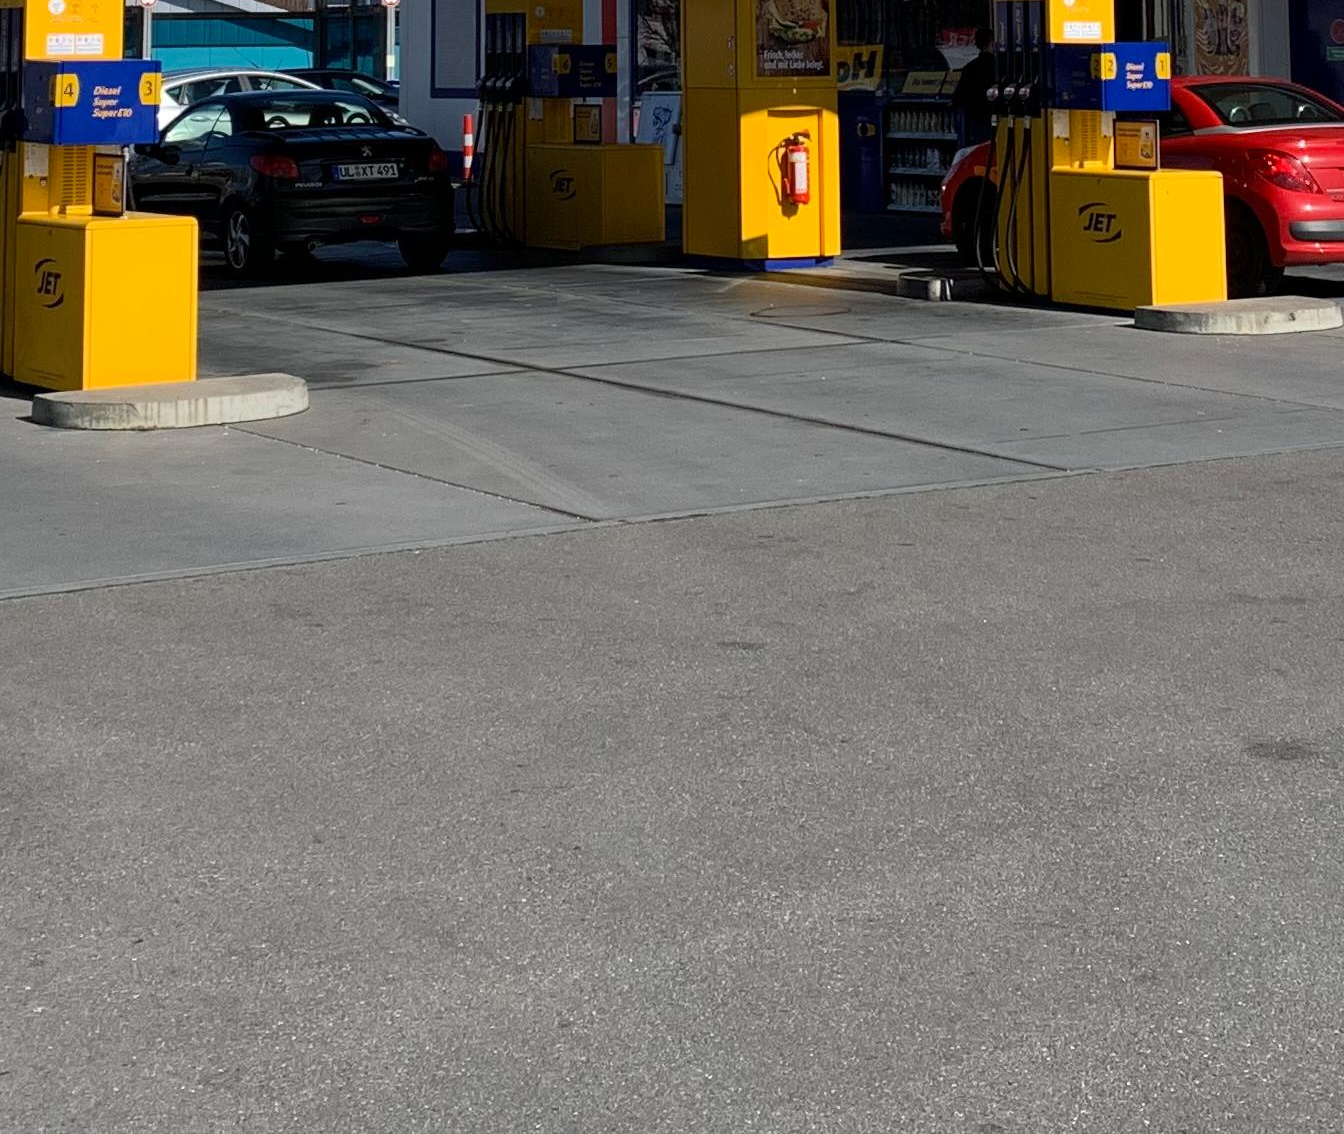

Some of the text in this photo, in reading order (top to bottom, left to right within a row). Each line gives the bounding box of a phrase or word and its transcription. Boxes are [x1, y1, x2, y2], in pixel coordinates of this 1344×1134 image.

[63, 82, 75, 98] 4
[93, 85, 122, 96] Diesel
[144, 80, 154, 97] 3
[92, 97, 119, 109] Super
[339, 166, 354, 178] UL
[552, 177, 574, 194] JET
[1083, 212, 1117, 234] JET
[37, 270, 62, 296] JET
